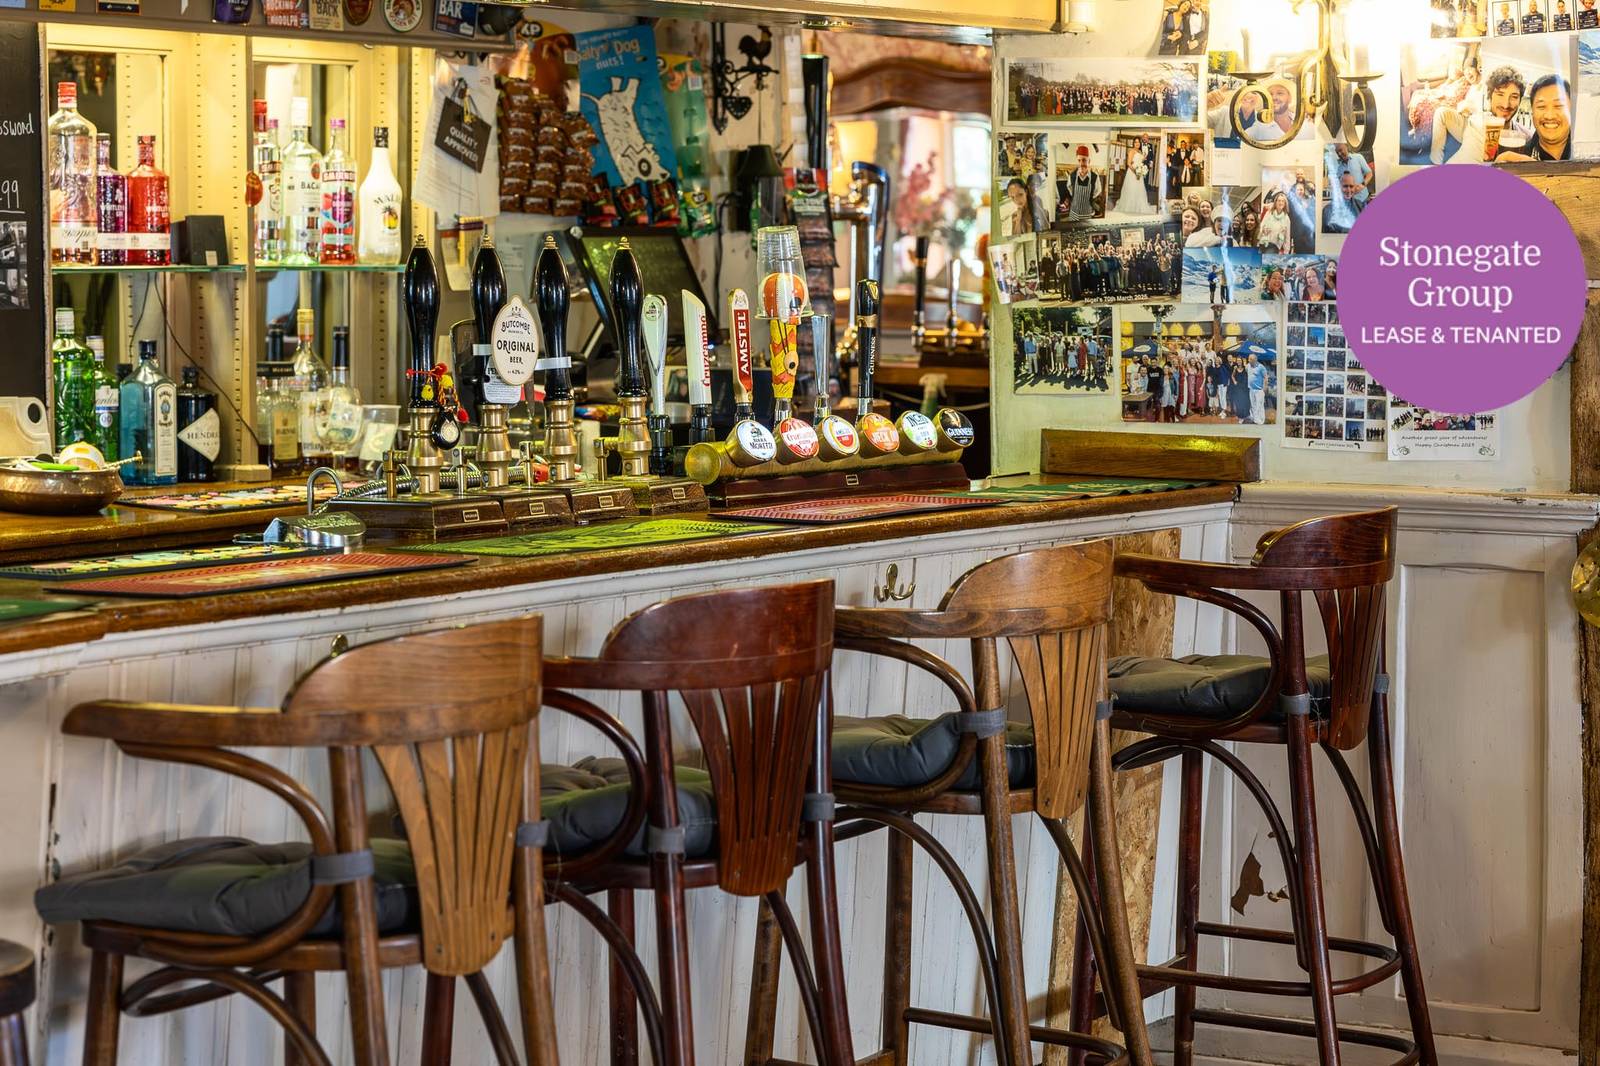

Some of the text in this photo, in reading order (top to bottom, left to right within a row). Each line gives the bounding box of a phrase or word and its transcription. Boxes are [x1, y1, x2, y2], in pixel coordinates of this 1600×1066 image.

[438, 0, 463, 19] BAR
[443, 135, 479, 162] APPROVED
[449, 125, 478, 149] QUALITY
[501, 320, 531, 335] BUTCOMBE
[496, 339, 536, 354] ORIGINAL
[700, 314, 711, 387] Cruzcampo
[737, 311, 750, 375] AMSTEL
[509, 356, 524, 365] BEER
[868, 336, 876, 375] GUINNESS
